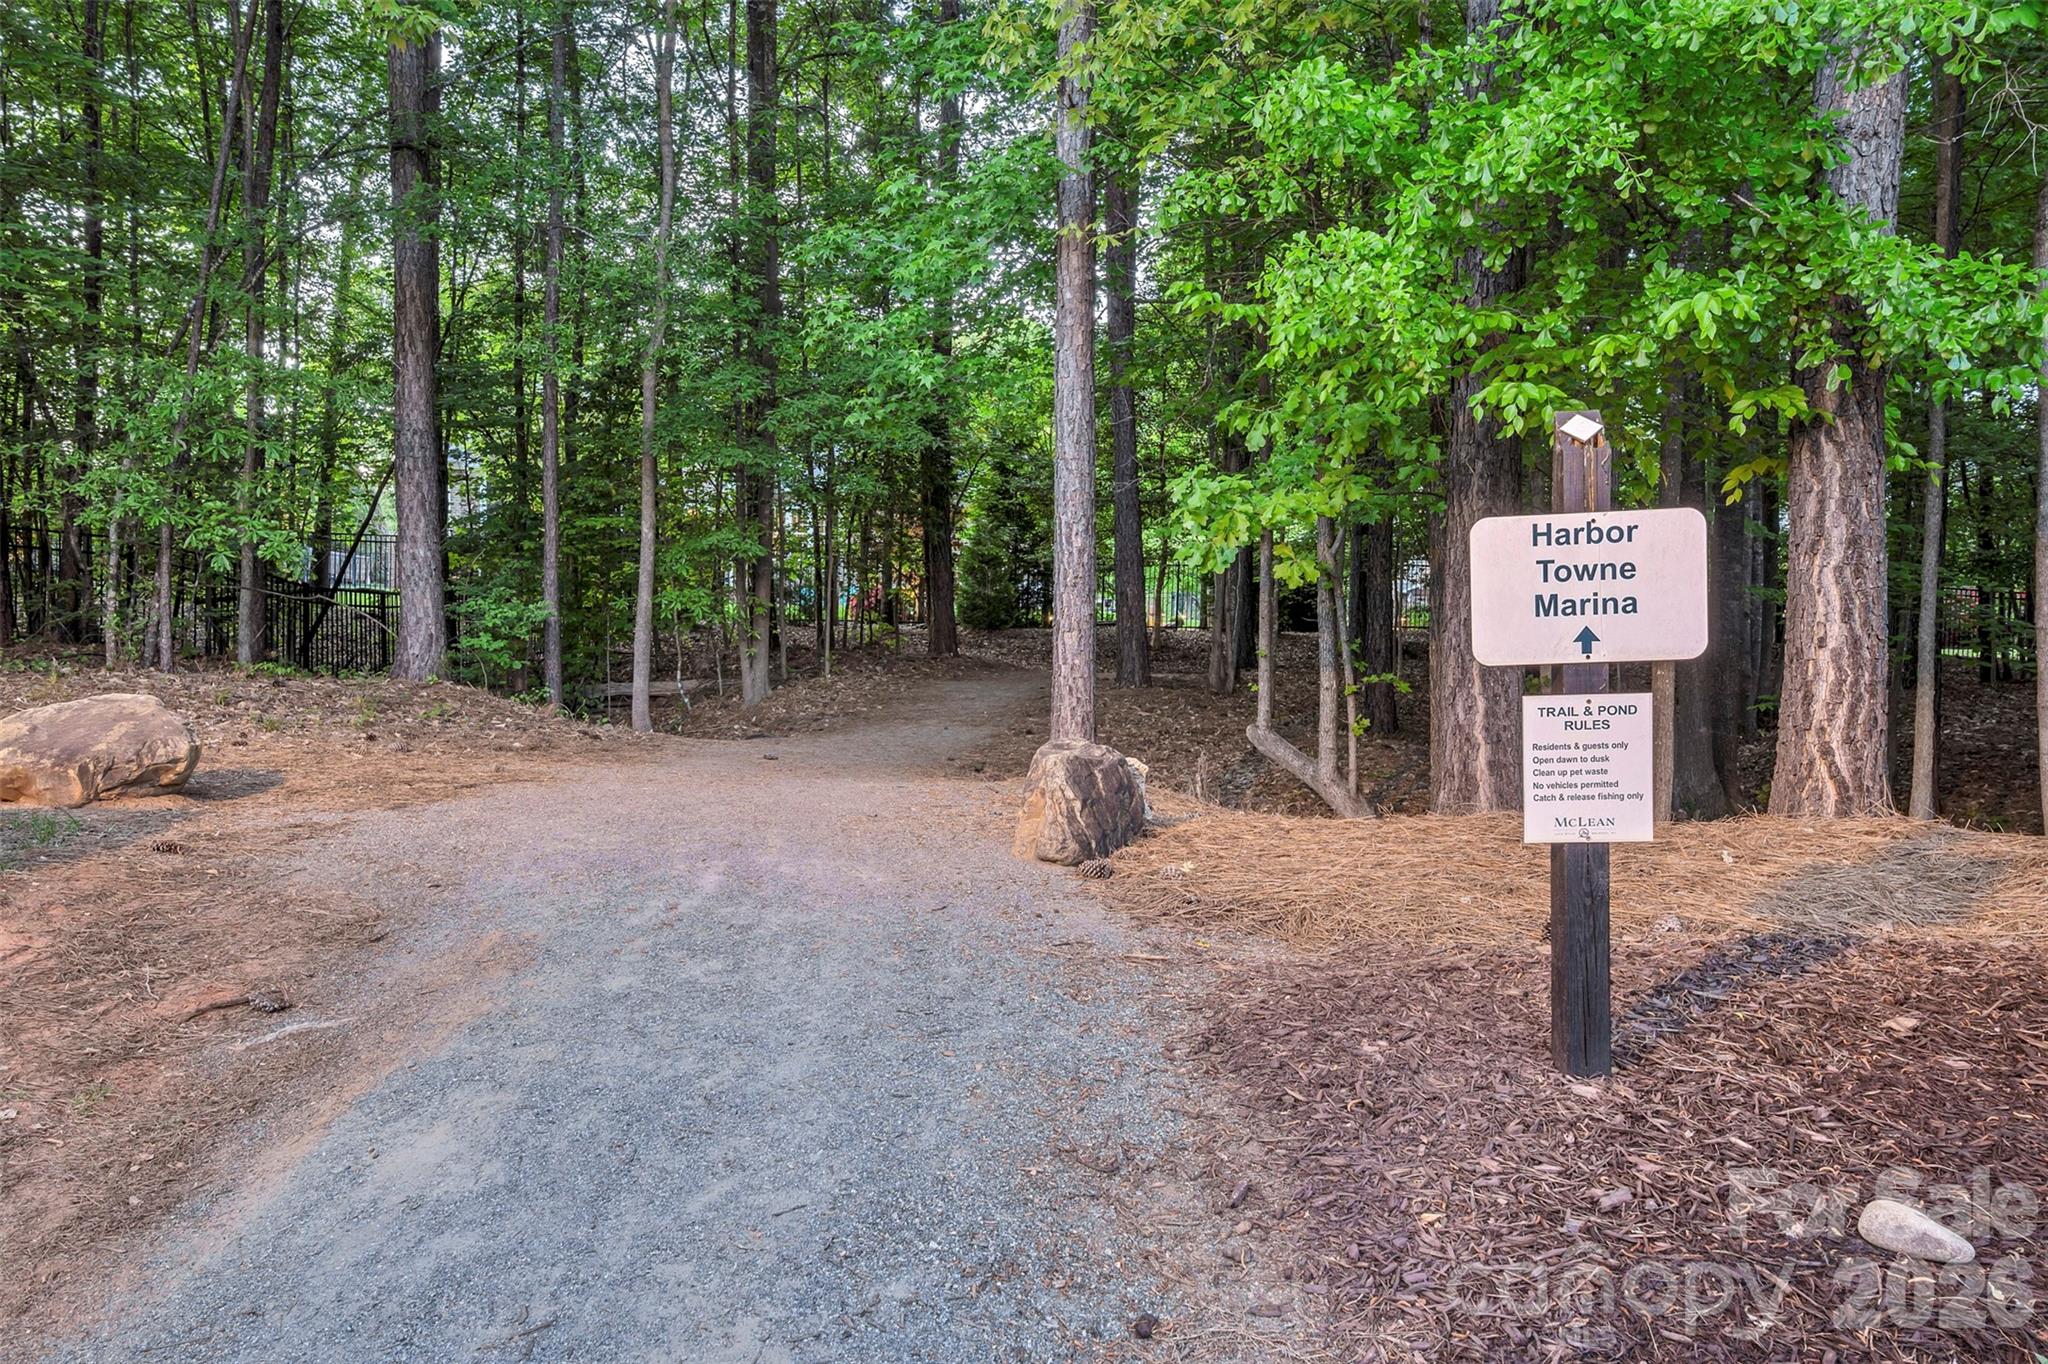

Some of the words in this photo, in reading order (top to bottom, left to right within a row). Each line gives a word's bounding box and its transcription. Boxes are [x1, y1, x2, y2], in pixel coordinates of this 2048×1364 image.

[1532, 521, 1639, 547] Harbor
[1535, 559, 1637, 583] Towne
[1534, 592, 1638, 617] Marina
[1537, 707, 1579, 717] TRAIL
[1583, 705, 1593, 717] &
[1598, 705, 1638, 715] POND
[1564, 720, 1610, 730] RULES
[1532, 742, 1571, 751] Residents
[1574, 742, 1580, 750] &
[1582, 743, 1609, 751] guests
[1611, 741, 1629, 751] only
[1532, 757, 1554, 765] Open
[1556, 755, 1578, 764] dawn
[1590, 755, 1610, 763] dusk
[1532, 768, 1555, 777] Clean
[1557, 770, 1567, 778] up
[1570, 769, 1583, 778] pet
[1585, 768, 1609, 776] waste
[1532, 782, 1545, 790] No
[1546, 781, 1578, 790] vehicles
[1580, 780, 1619, 790] permitted
[1533, 794, 1557, 802] Catch
[1558, 793, 1565, 802] &
[1567, 793, 1596, 802] release
[1598, 792, 1625, 802] fishing
[1627, 792, 1644, 802] only
